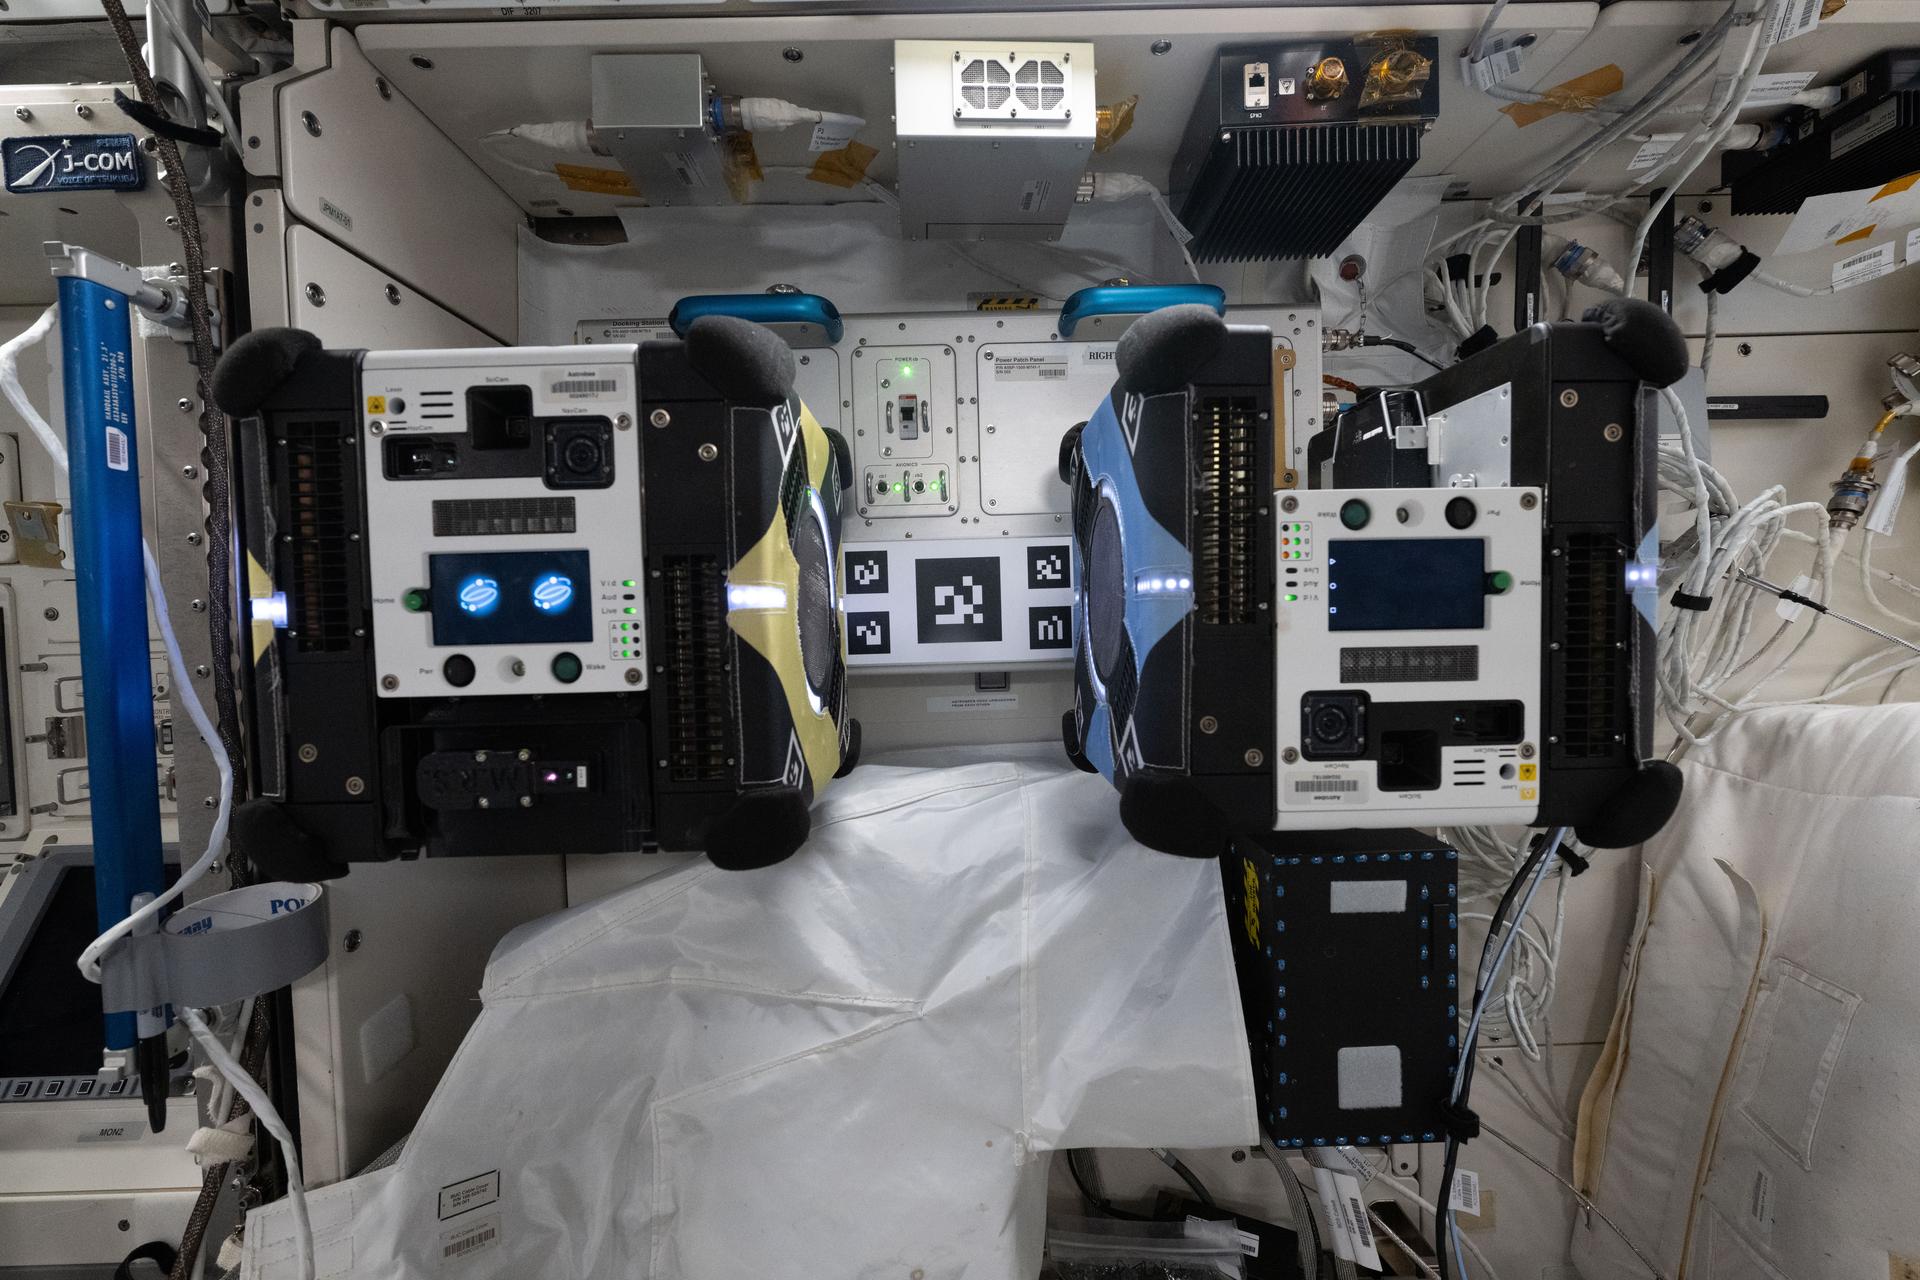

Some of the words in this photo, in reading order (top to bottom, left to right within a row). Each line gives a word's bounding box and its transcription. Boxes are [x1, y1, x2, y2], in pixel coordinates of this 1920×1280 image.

[501, 7, 514, 16] DIF
[523, 6, 542, 16] 3207
[63, 151, 134, 173] J-COM
[270, 898, 307, 914] PO
[99, 1128, 124, 1136] MON2
